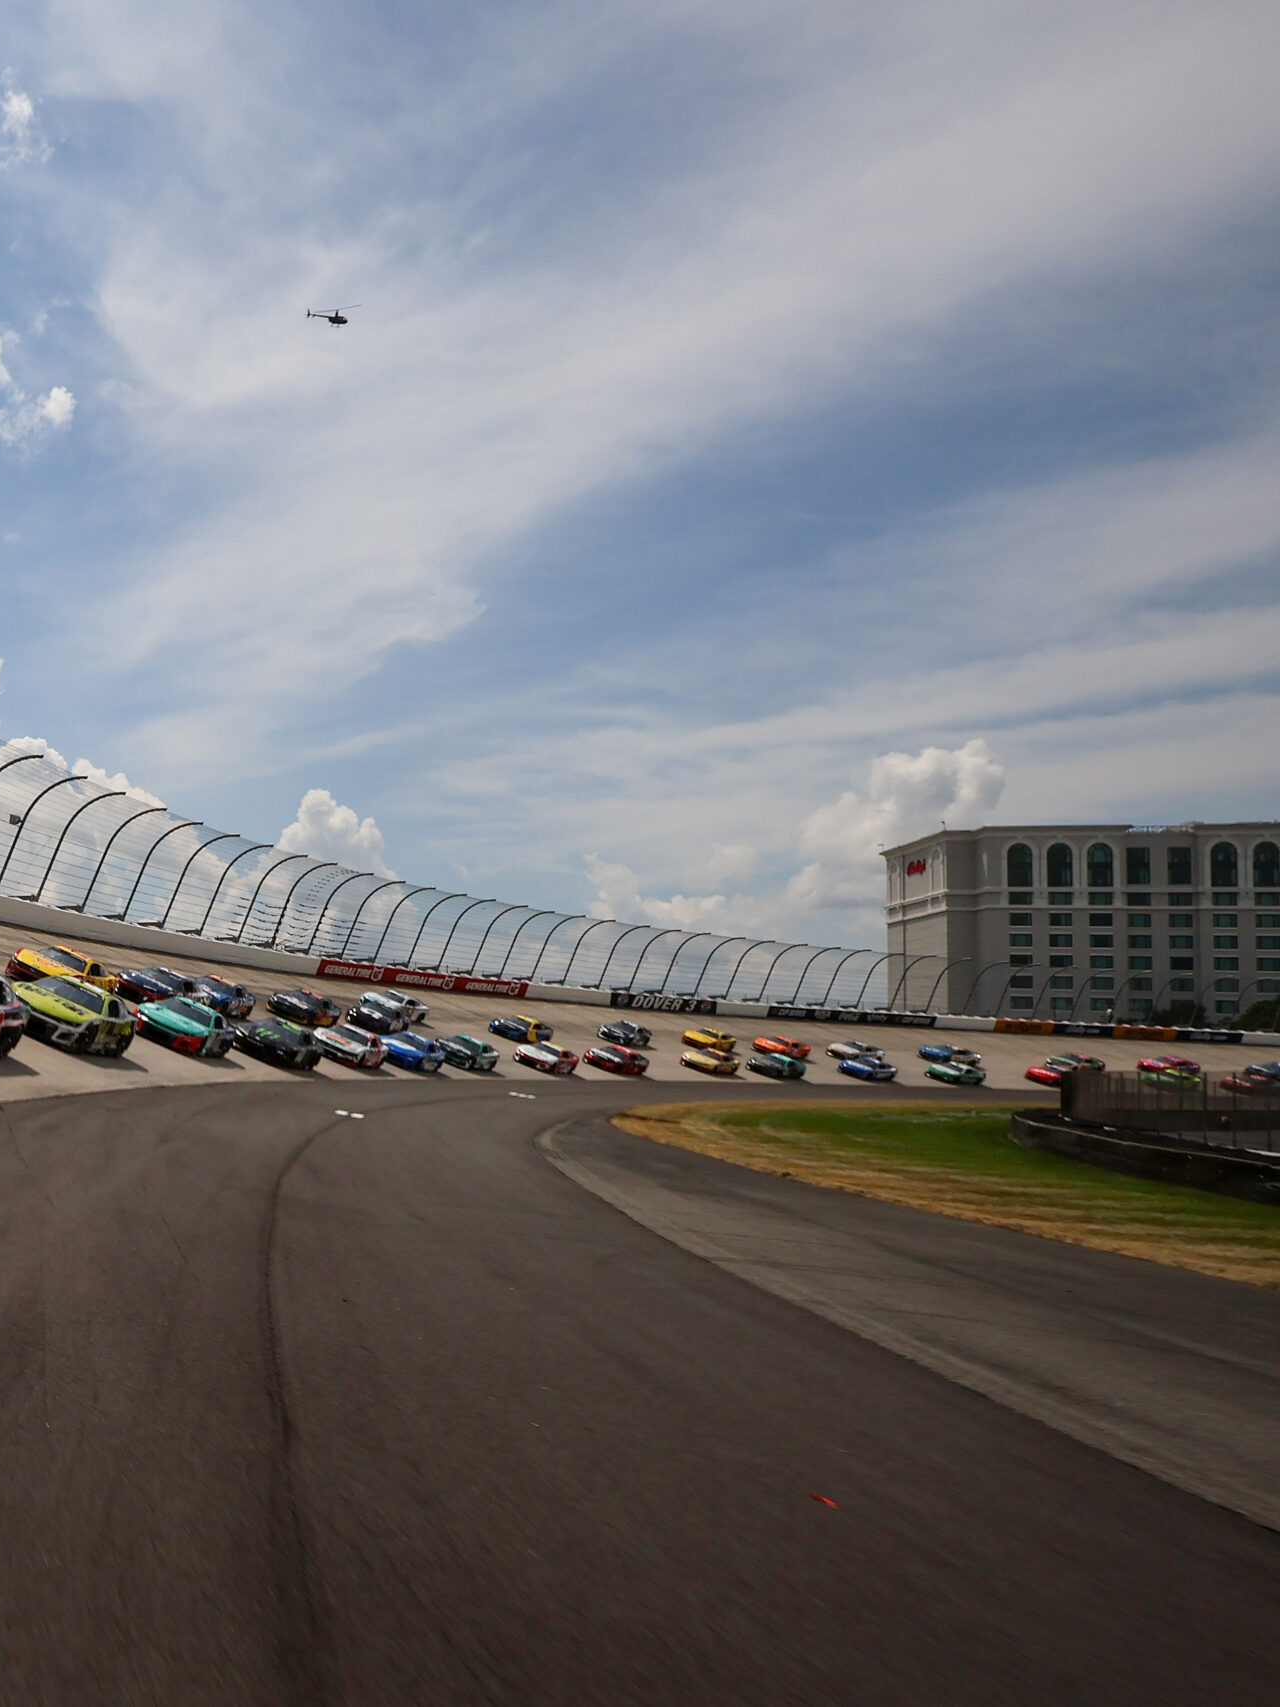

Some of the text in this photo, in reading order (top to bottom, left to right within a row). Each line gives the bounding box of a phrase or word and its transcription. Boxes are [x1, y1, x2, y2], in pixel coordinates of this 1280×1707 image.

[324, 965, 372, 978] GENERAL TIRE
[395, 973, 444, 987] GENERAL TIRE
[465, 981, 509, 993] GENERAL TIRE
[631, 995, 698, 1012] DOVER 3
